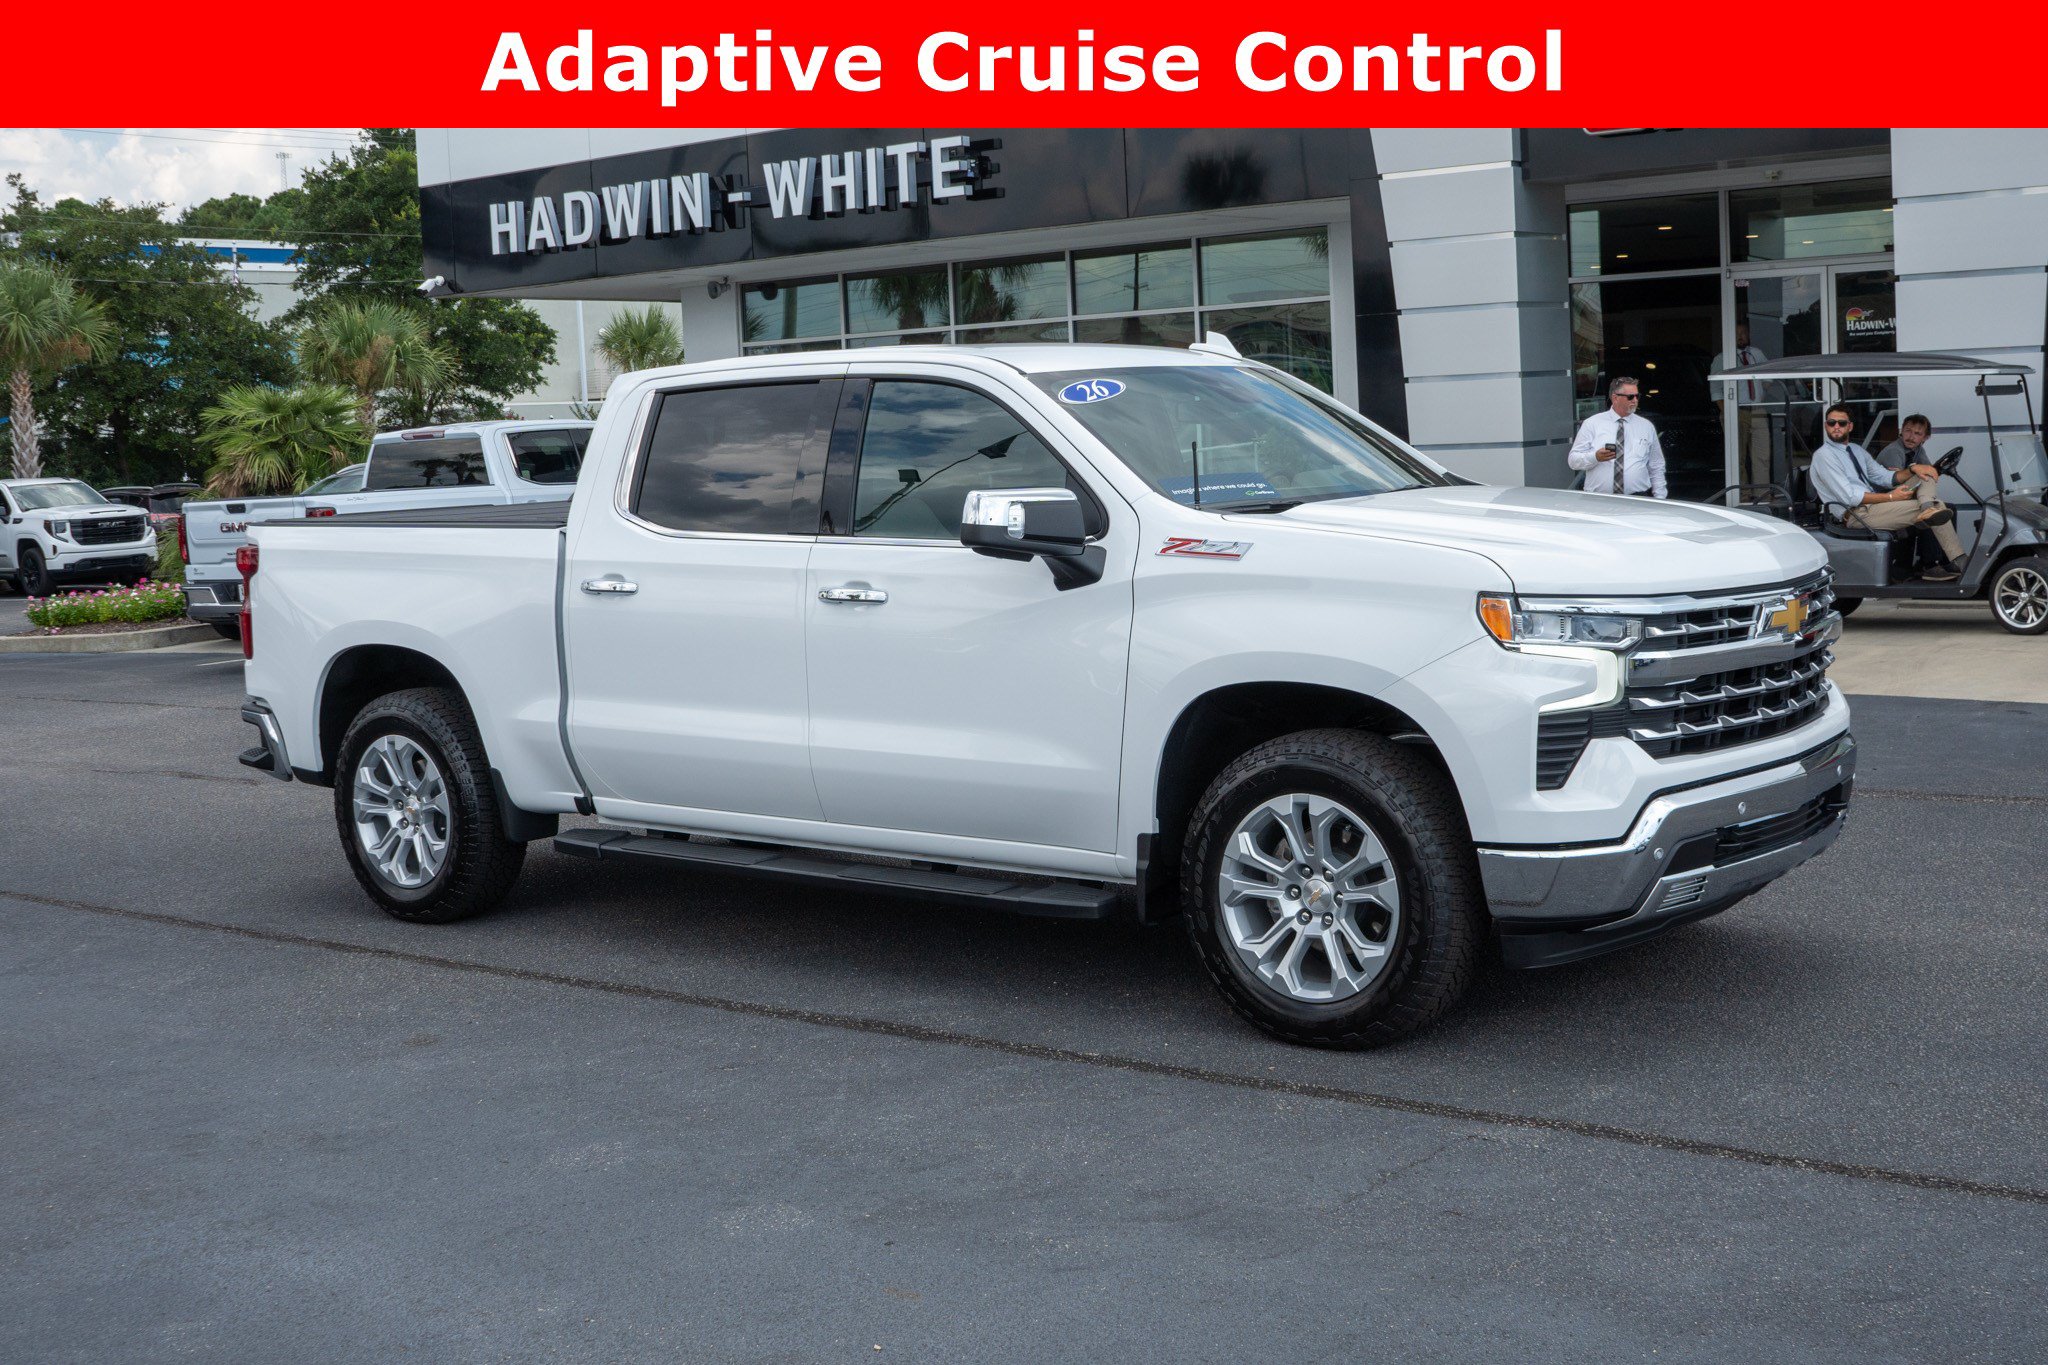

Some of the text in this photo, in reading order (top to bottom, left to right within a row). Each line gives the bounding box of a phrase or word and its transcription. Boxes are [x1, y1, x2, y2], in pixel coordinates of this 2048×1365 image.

[489, 173, 711, 255] HADWIN
[762, 136, 973, 219] WHITE
[1076, 380, 1109, 401] 26
[220, 522, 249, 533] GM
[1155, 536, 1254, 561] Z71
